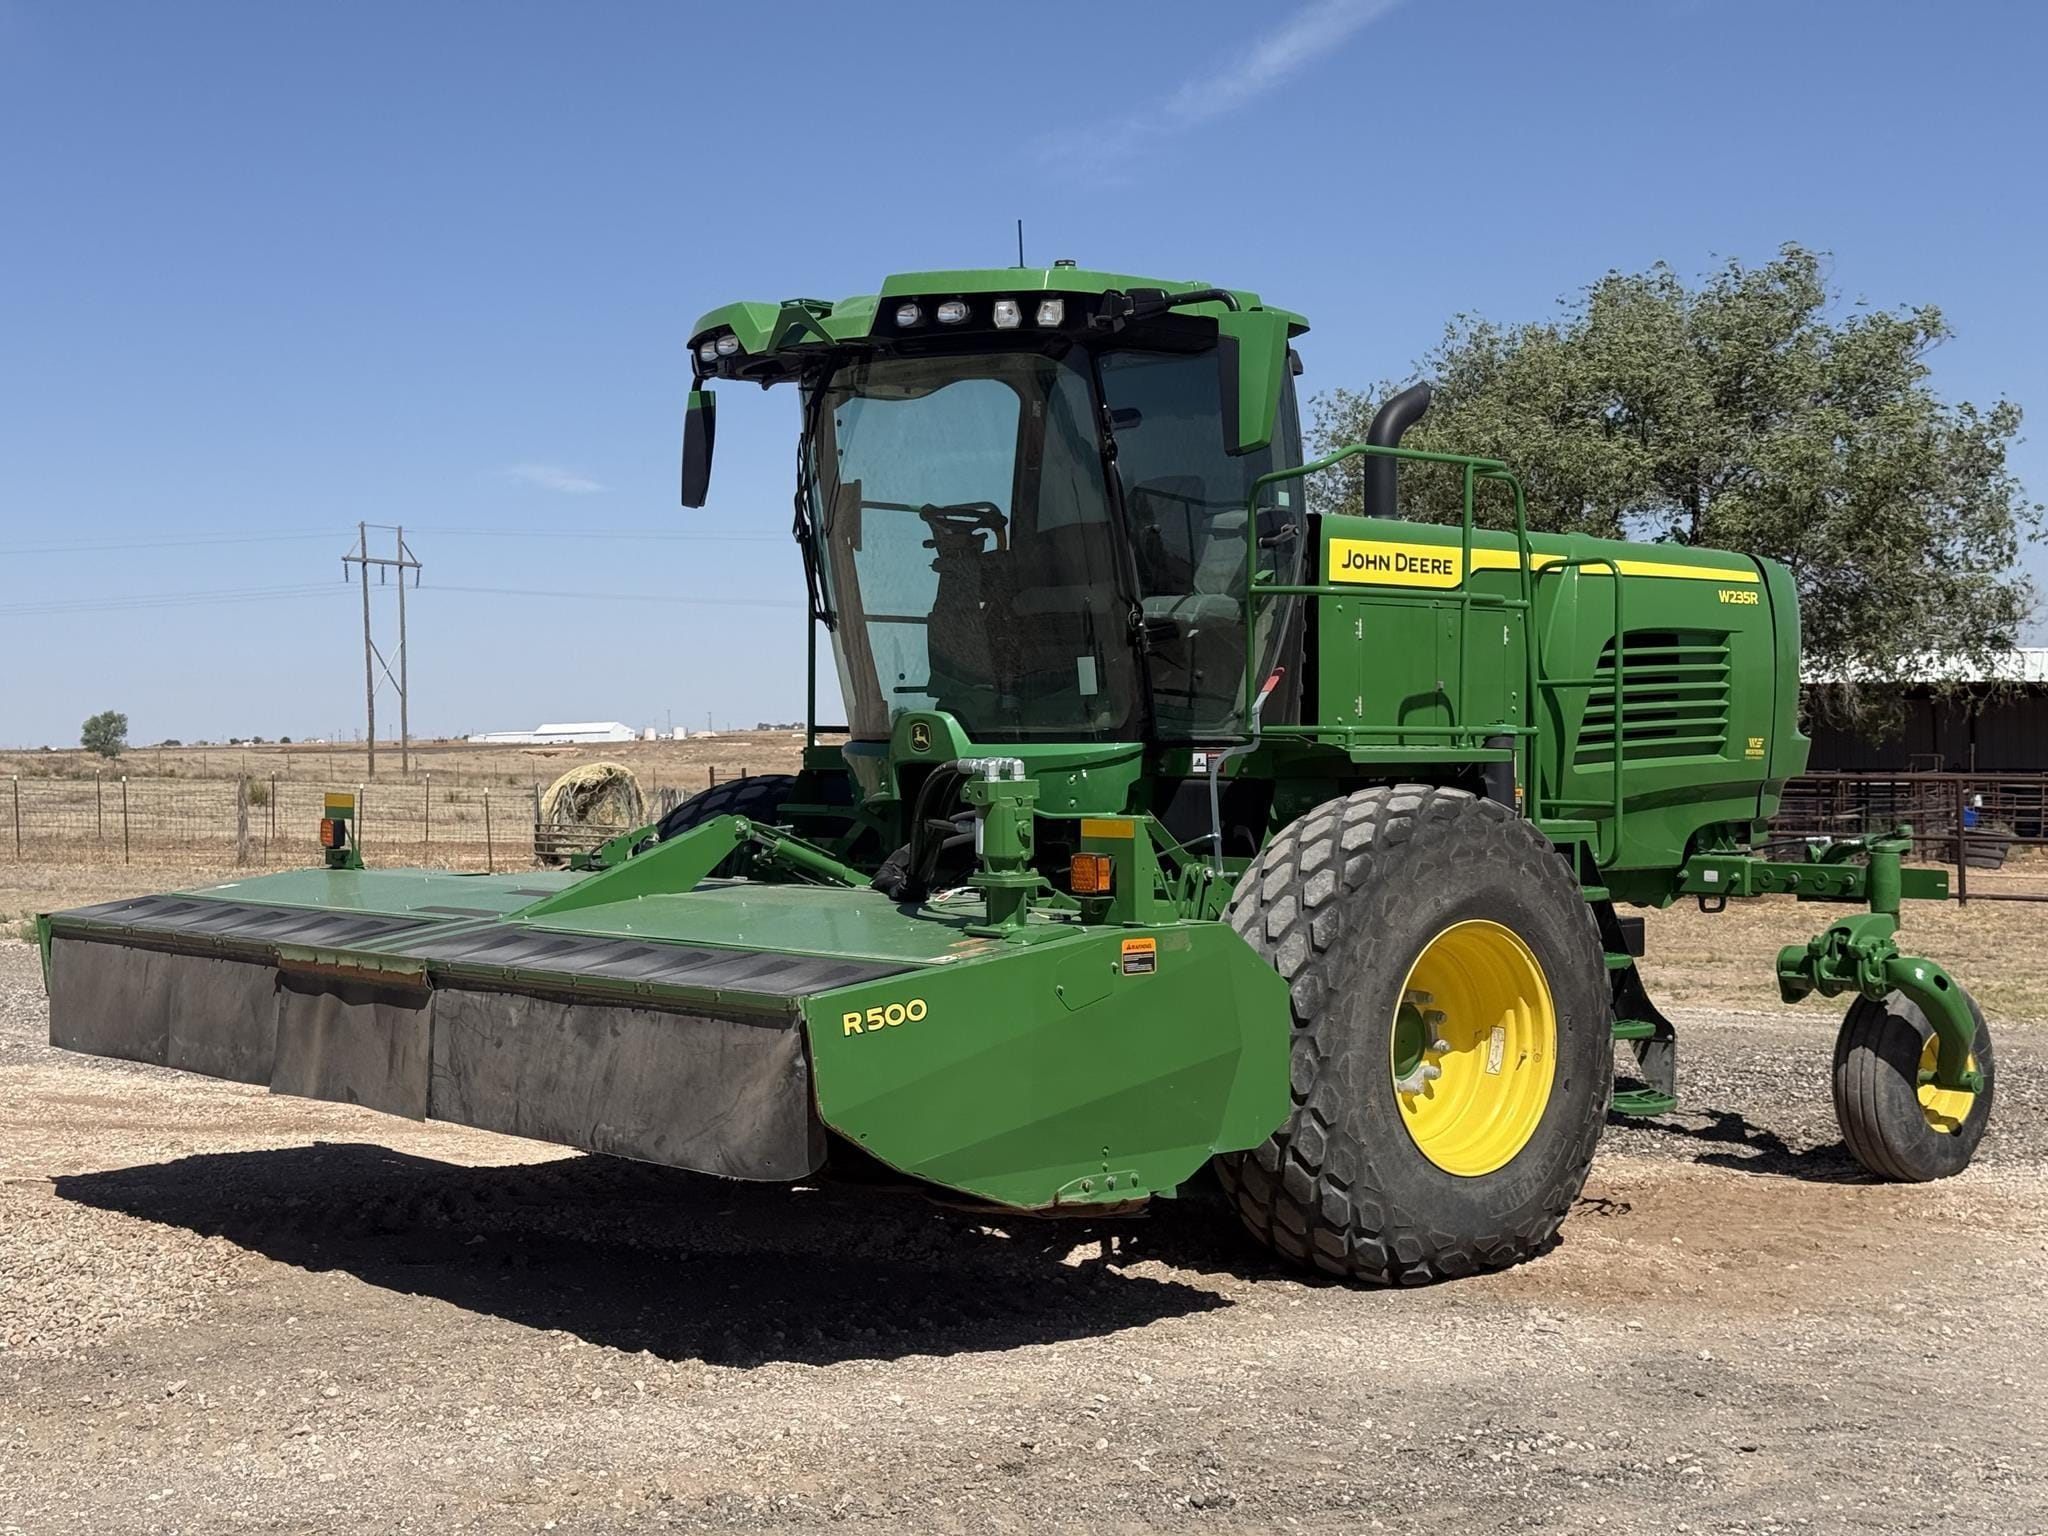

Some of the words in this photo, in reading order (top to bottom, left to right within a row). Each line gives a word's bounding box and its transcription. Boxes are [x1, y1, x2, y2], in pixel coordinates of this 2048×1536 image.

[1341, 549, 1390, 571] JOHN
[1395, 552, 1453, 575] DEERE
[1718, 589, 1759, 605] W235R
[842, 998, 928, 1037] R500
